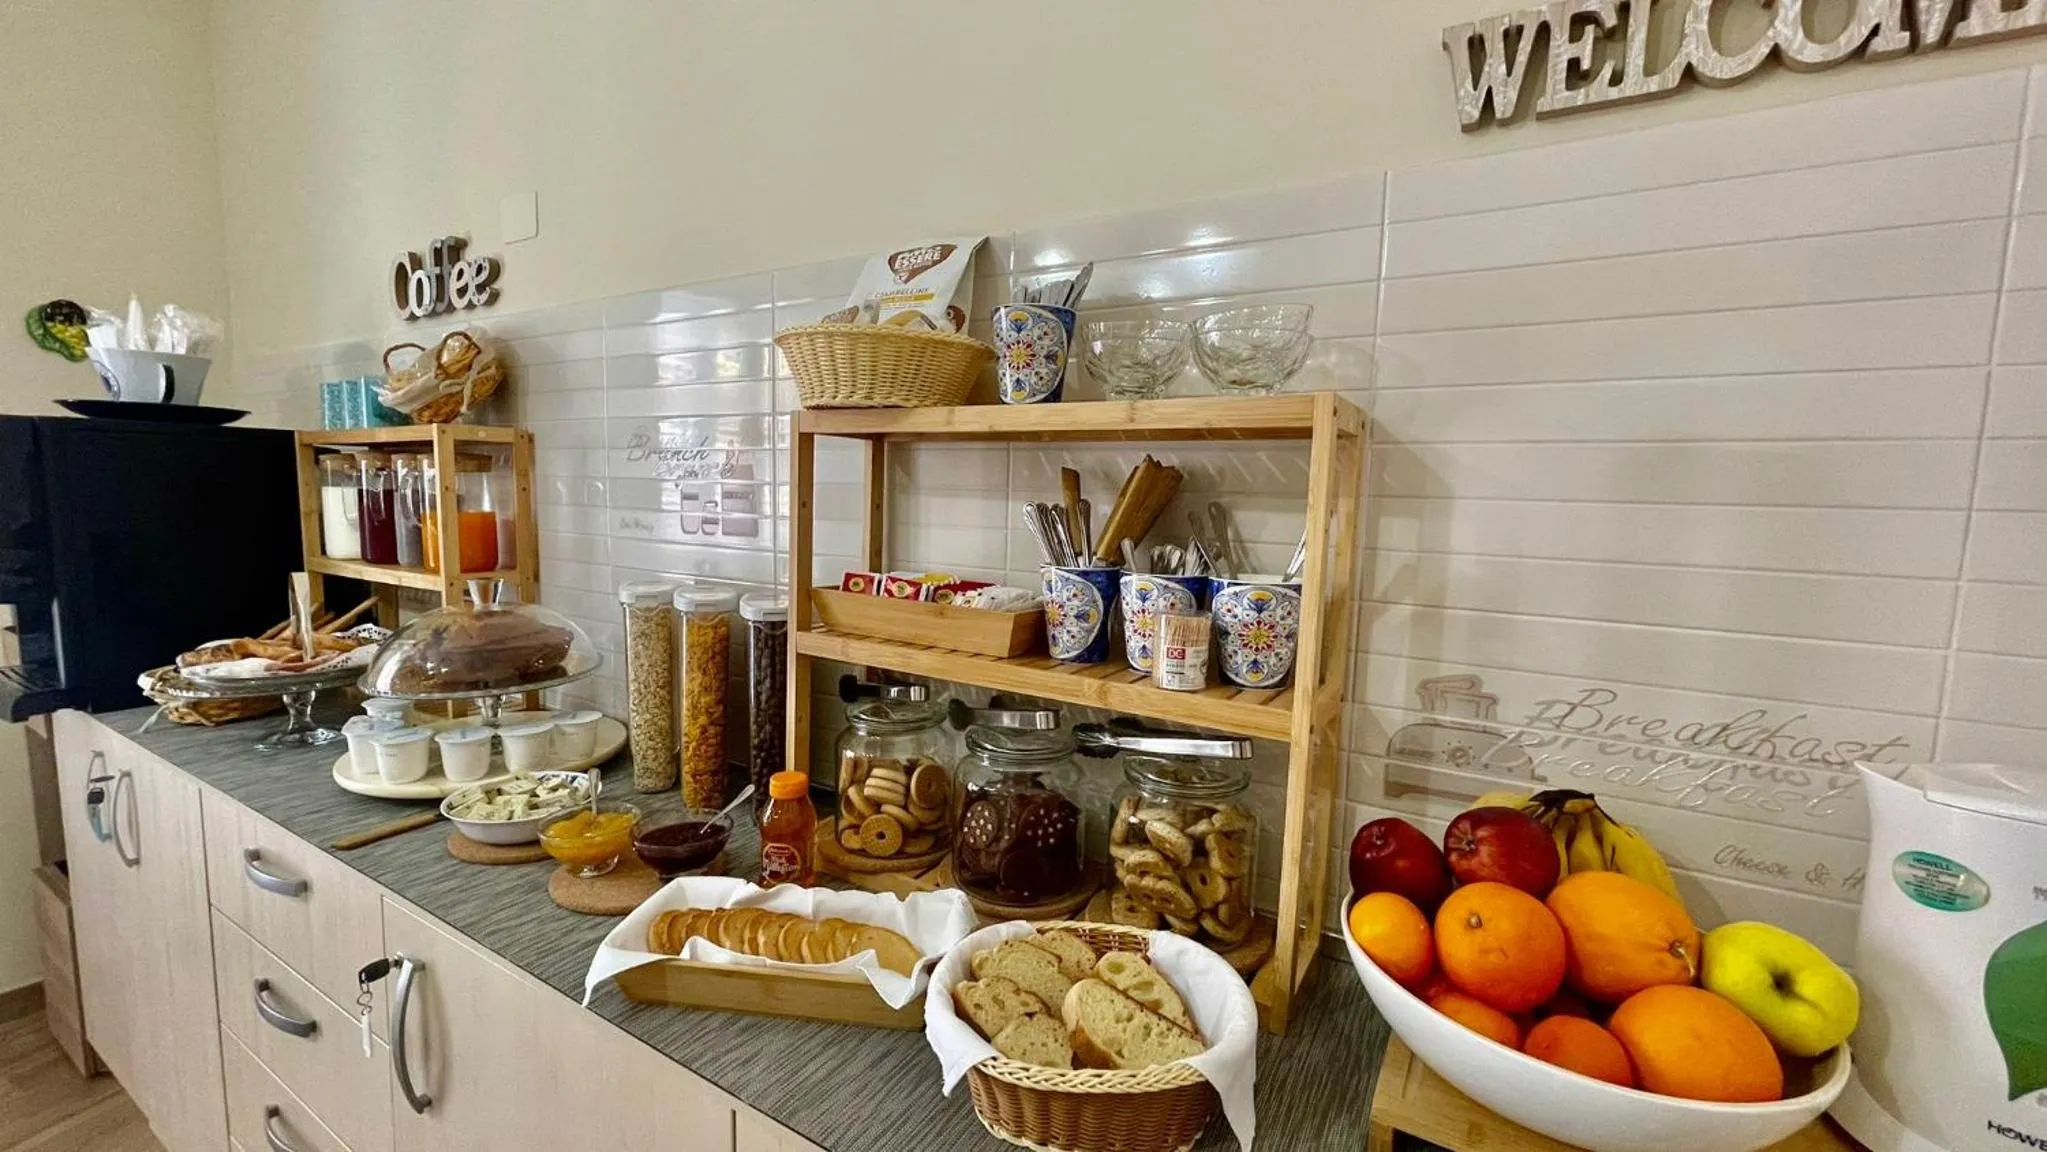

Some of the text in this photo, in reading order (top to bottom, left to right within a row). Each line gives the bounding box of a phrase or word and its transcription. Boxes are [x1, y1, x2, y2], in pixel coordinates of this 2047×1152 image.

[1442, 0, 2047, 133] WELCOM
[392, 235, 500, 320] Coffee
[894, 246, 942, 270] ESSERE
[1912, 857, 1954, 872] HOWELL
